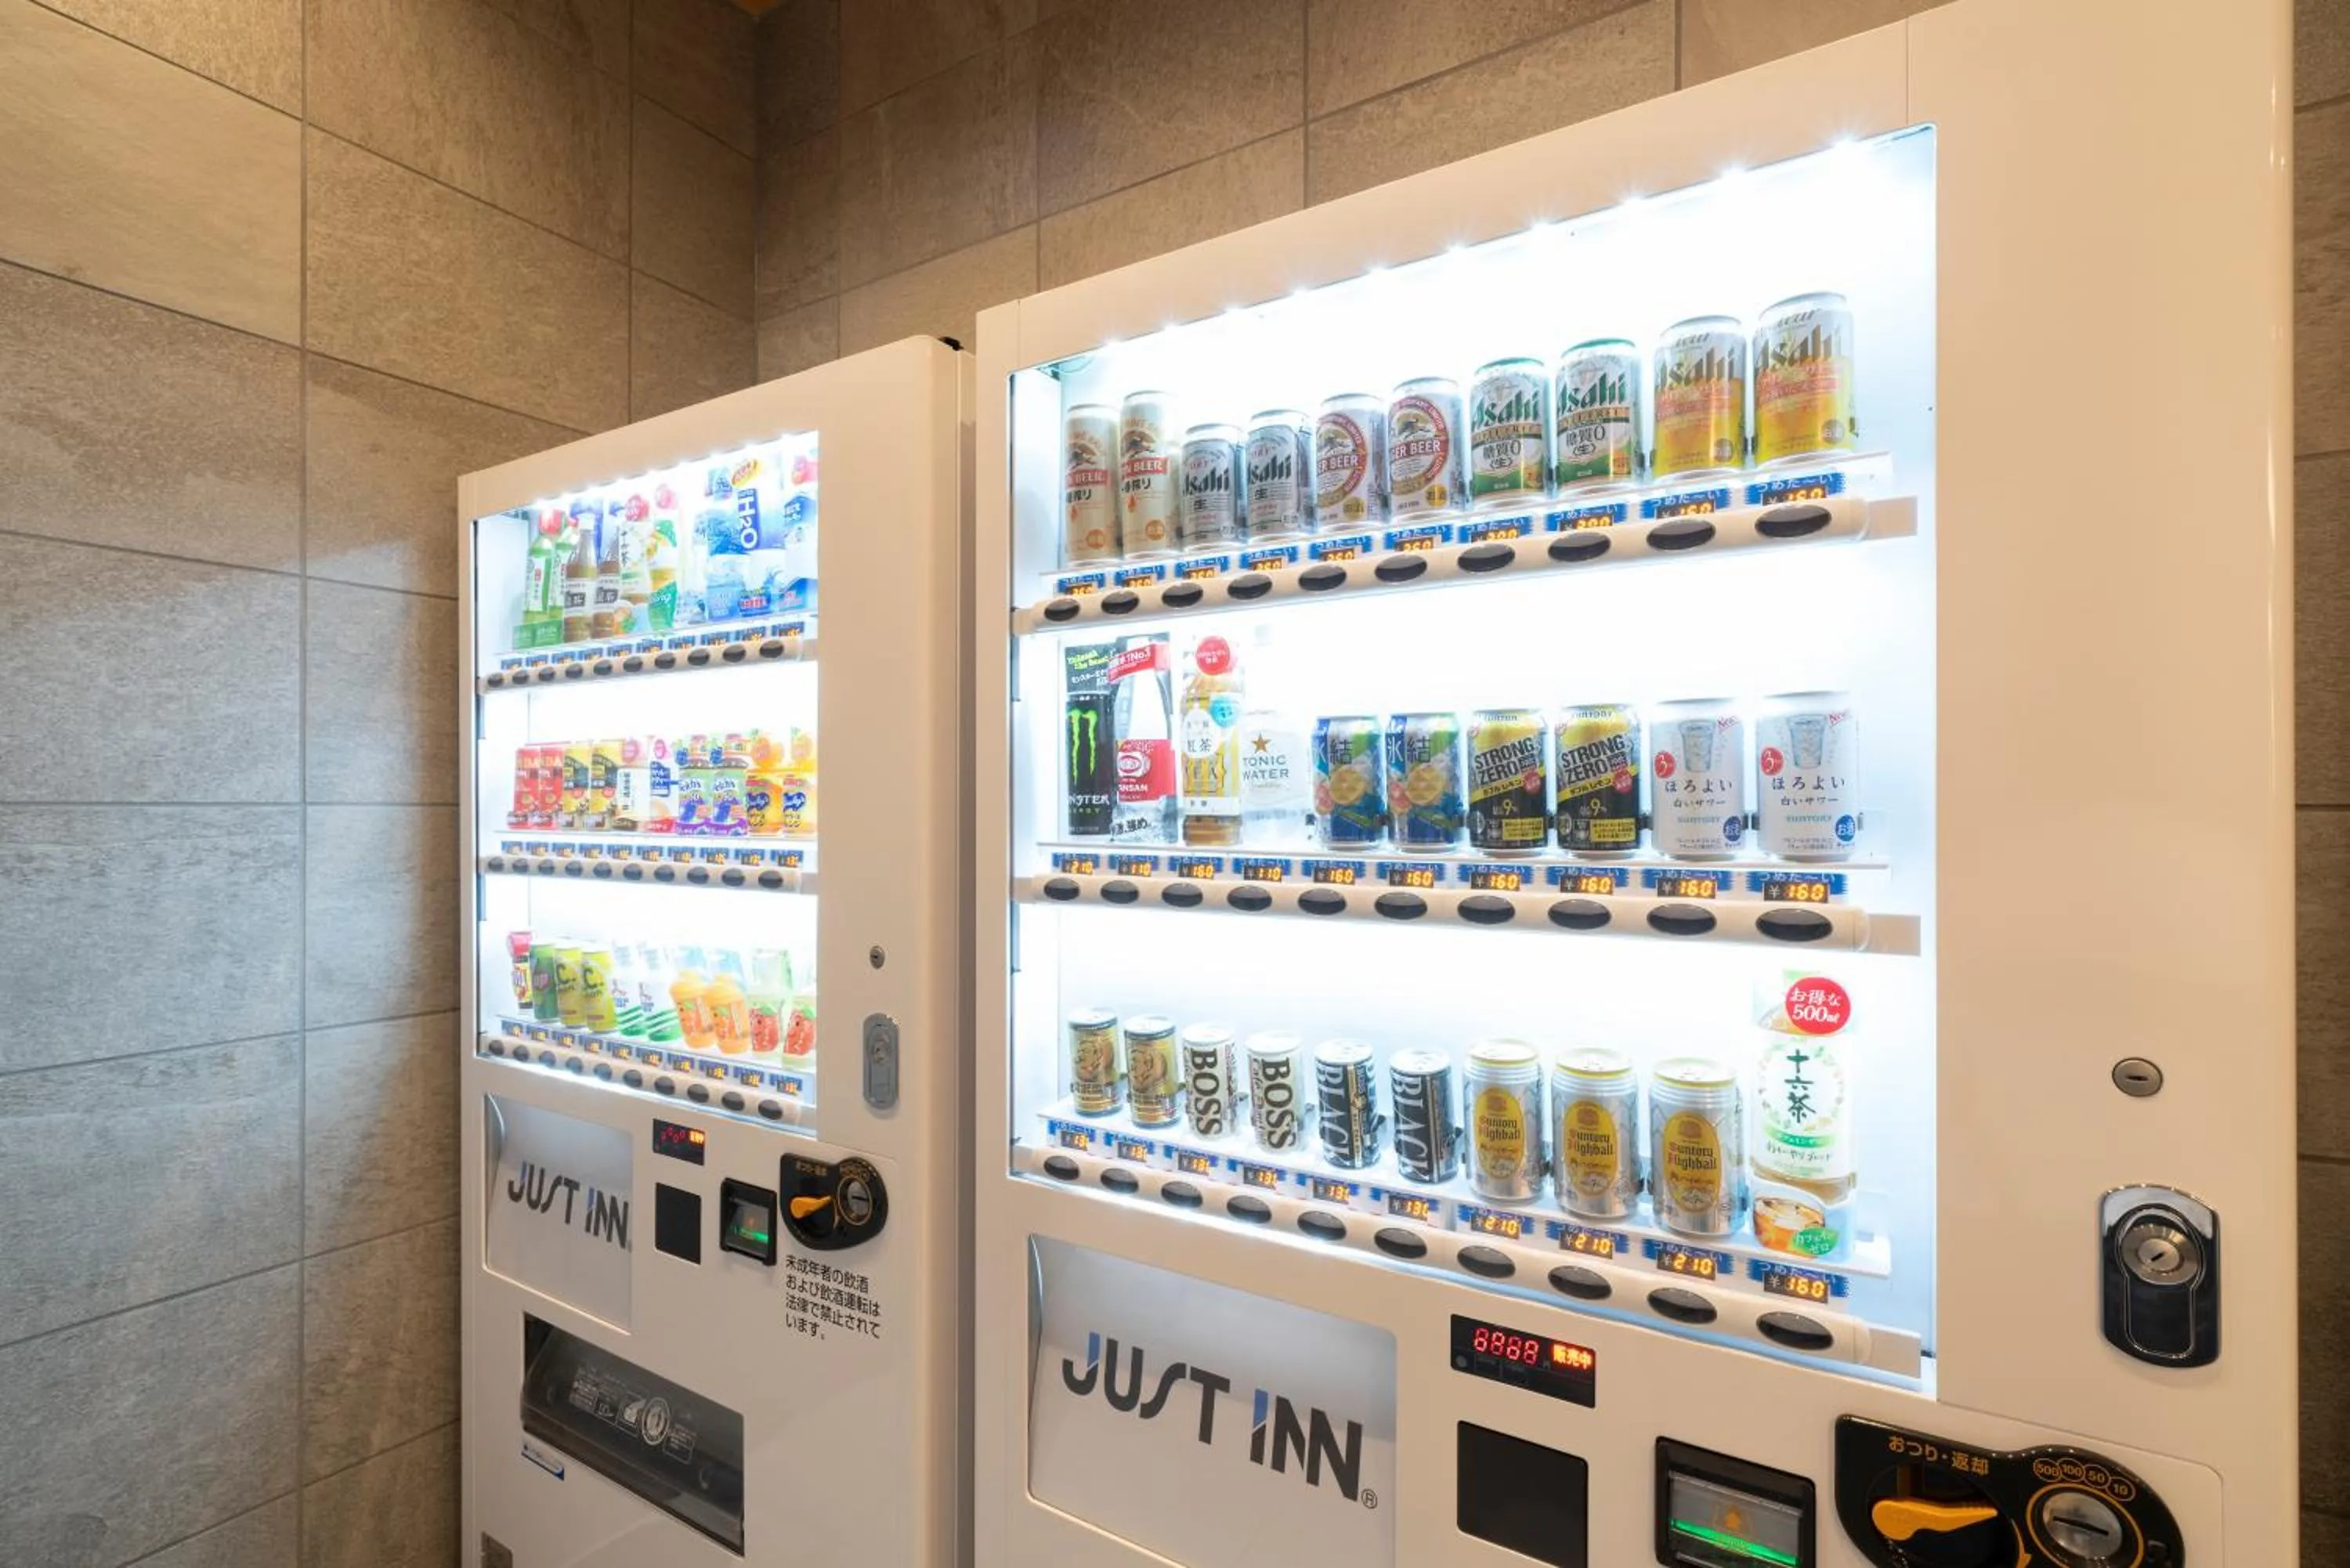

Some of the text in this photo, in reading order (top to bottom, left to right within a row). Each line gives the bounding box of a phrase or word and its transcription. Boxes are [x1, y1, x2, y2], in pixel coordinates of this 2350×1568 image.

[1330, 456, 1358, 470] BEER
[1410, 439, 1441, 456] BEER
[1242, 755, 1286, 767] TONIC
[1474, 737, 1535, 769] STRONG
[1561, 735, 1626, 768] STRONG
[1243, 768, 1289, 780] WATER
[1477, 761, 1520, 784] ZERO
[1565, 759, 1607, 784] ZERO
[1665, 779, 1732, 793] ほろよい
[1772, 776, 1846, 791] ほろよい
[1791, 987, 1842, 1006] お得な
[1190, 1048, 1223, 1135] BOSS
[1784, 1049, 1816, 1124] 十六茶
[1260, 1057, 1296, 1149] BOSS
[1316, 1064, 1351, 1166] BLACK
[1391, 1072, 1430, 1181] BLACK
[507, 1160, 628, 1250] JUST INN
[786, 1254, 869, 1294] 未成年者の飲酒
[786, 1274, 880, 1317] および飲酒運転は
[786, 1292, 880, 1339] 法律で禁止されて
[786, 1312, 825, 1340] います。
[1061, 1331, 1363, 1503] JUST INN
[1888, 1435, 1990, 1476] おつり・返却
[2037, 1462, 2059, 1477] 500
[2063, 1465, 2083, 1478] 100
[2087, 1469, 2106, 1484] 50
